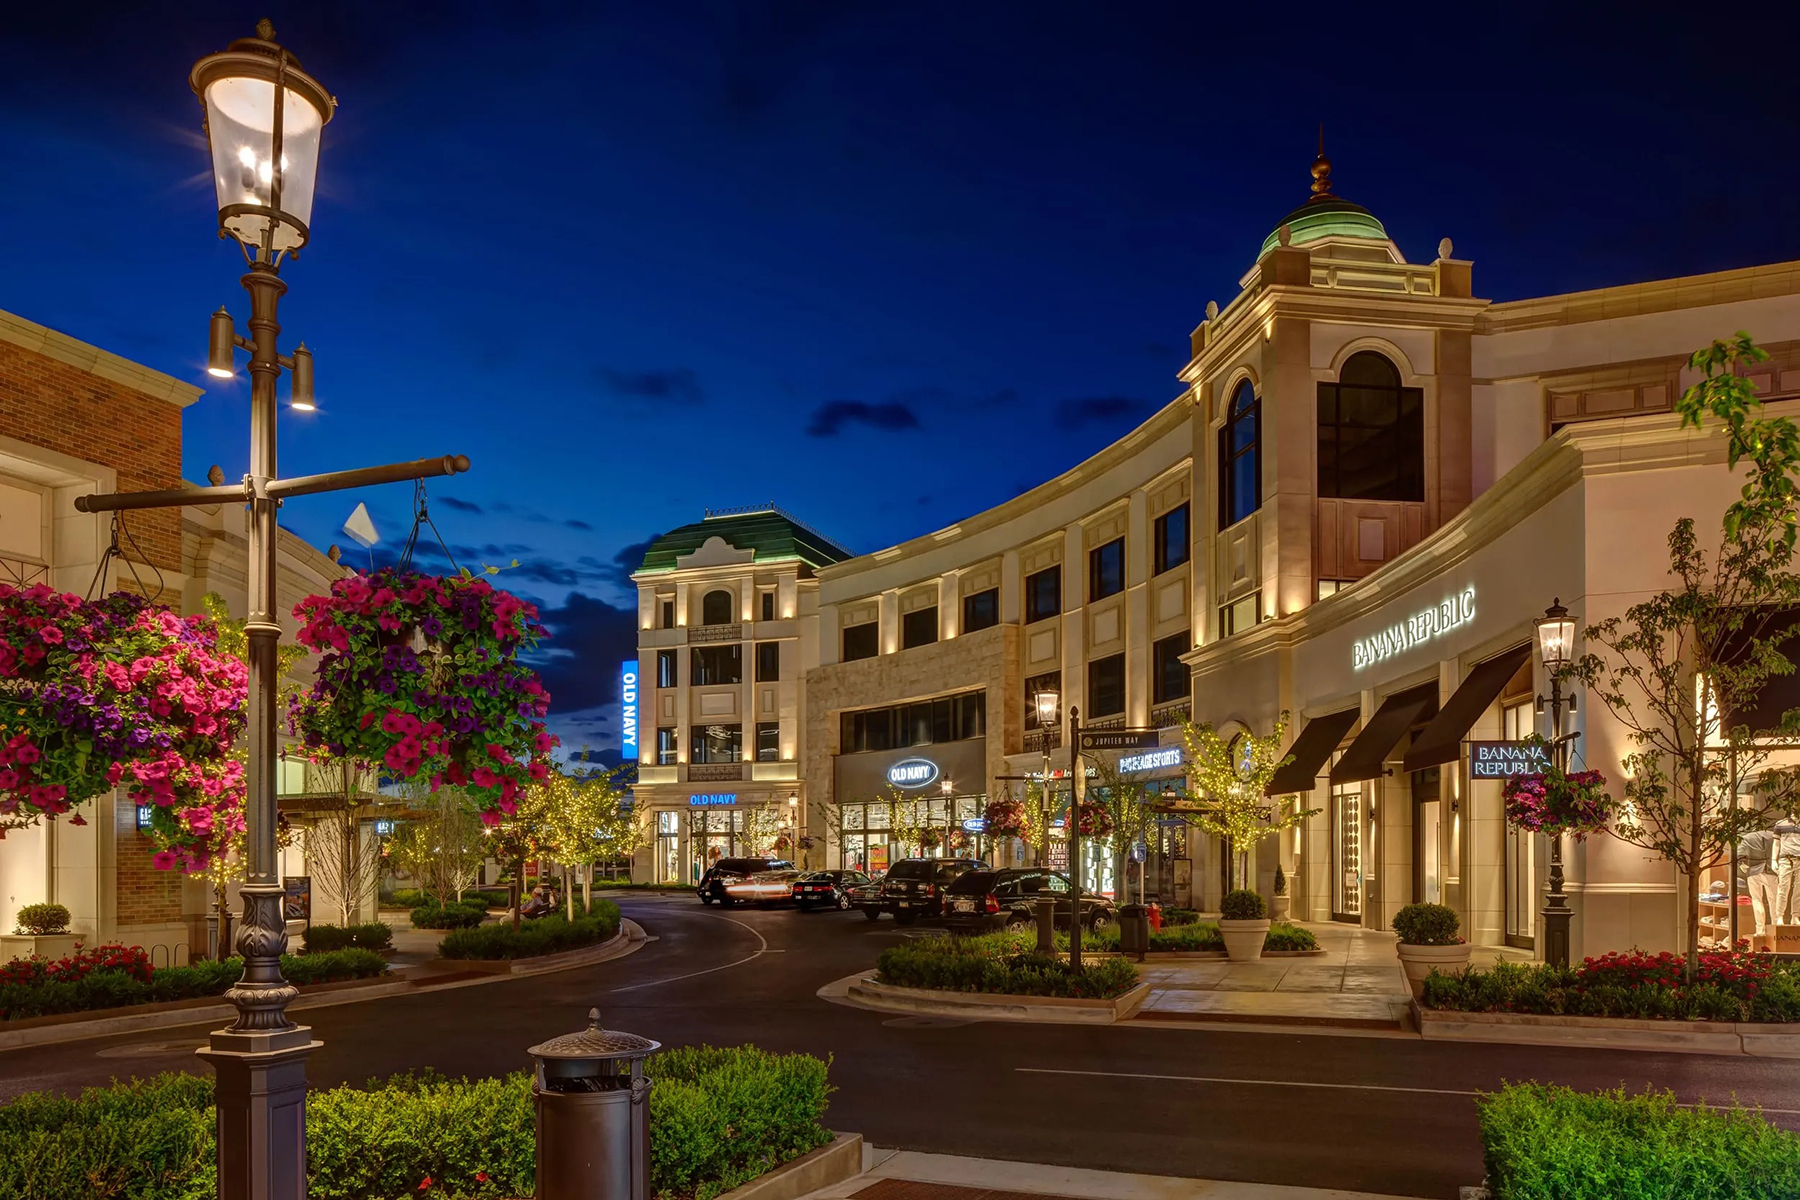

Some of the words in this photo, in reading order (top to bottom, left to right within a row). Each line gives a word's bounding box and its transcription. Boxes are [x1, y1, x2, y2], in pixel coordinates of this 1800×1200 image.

[1353, 621, 1407, 669] BANANA
[1406, 588, 1475, 647] REPUBLIC
[623, 672, 636, 703] OLD
[623, 706, 636, 746] NAVY
[1096, 737, 1122, 745] JUPITER
[1125, 736, 1139, 744] WAY
[1152, 749, 1180, 767] SPORTS
[1479, 746, 1547, 760] BANANA
[891, 768, 907, 781] OLD
[907, 765, 930, 780] NAVY
[1475, 761, 1552, 775] REPUBLC
[690, 795, 709, 806] OLD
[710, 794, 737, 805] NAVY
